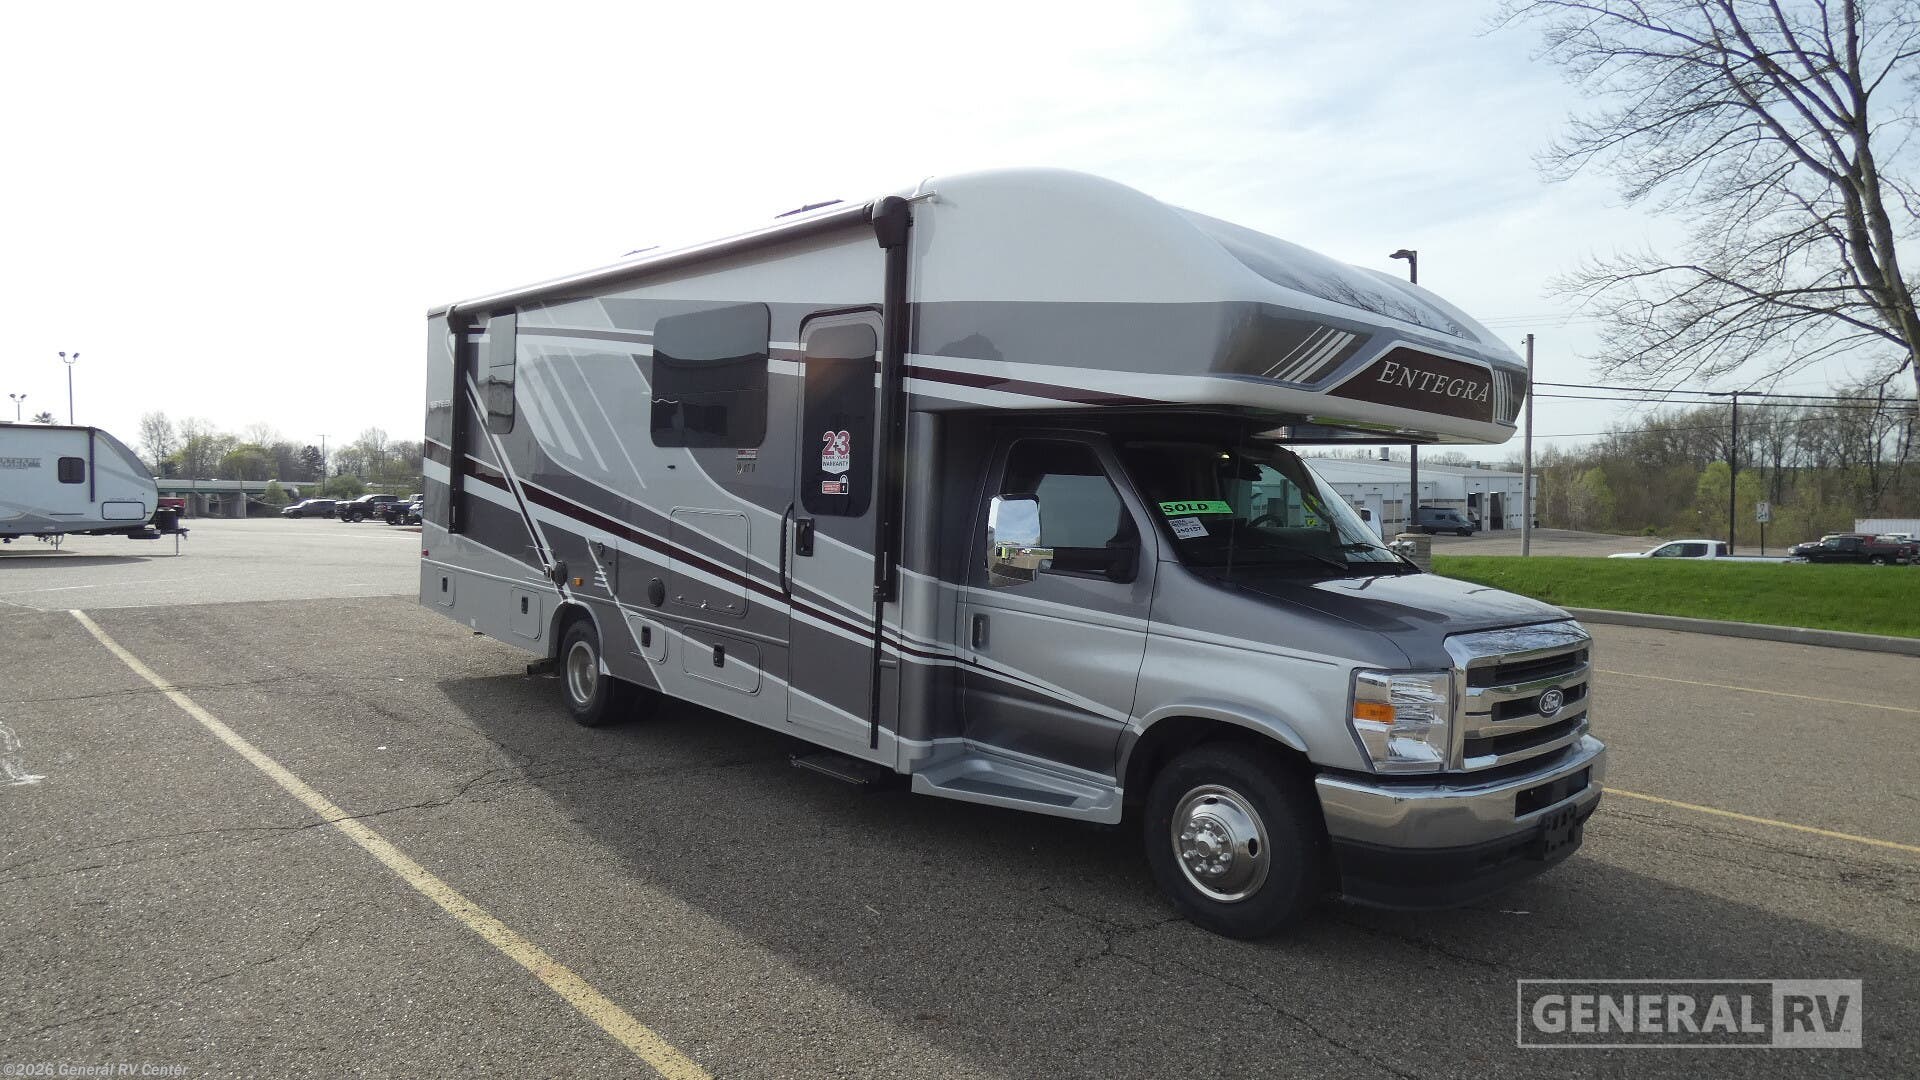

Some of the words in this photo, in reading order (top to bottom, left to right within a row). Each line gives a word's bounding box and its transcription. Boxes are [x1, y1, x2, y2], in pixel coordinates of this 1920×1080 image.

[1376, 360, 1491, 403] ENTEGRA
[1162, 503, 1209, 513] SOLD
[1542, 692, 1561, 711] Ford
